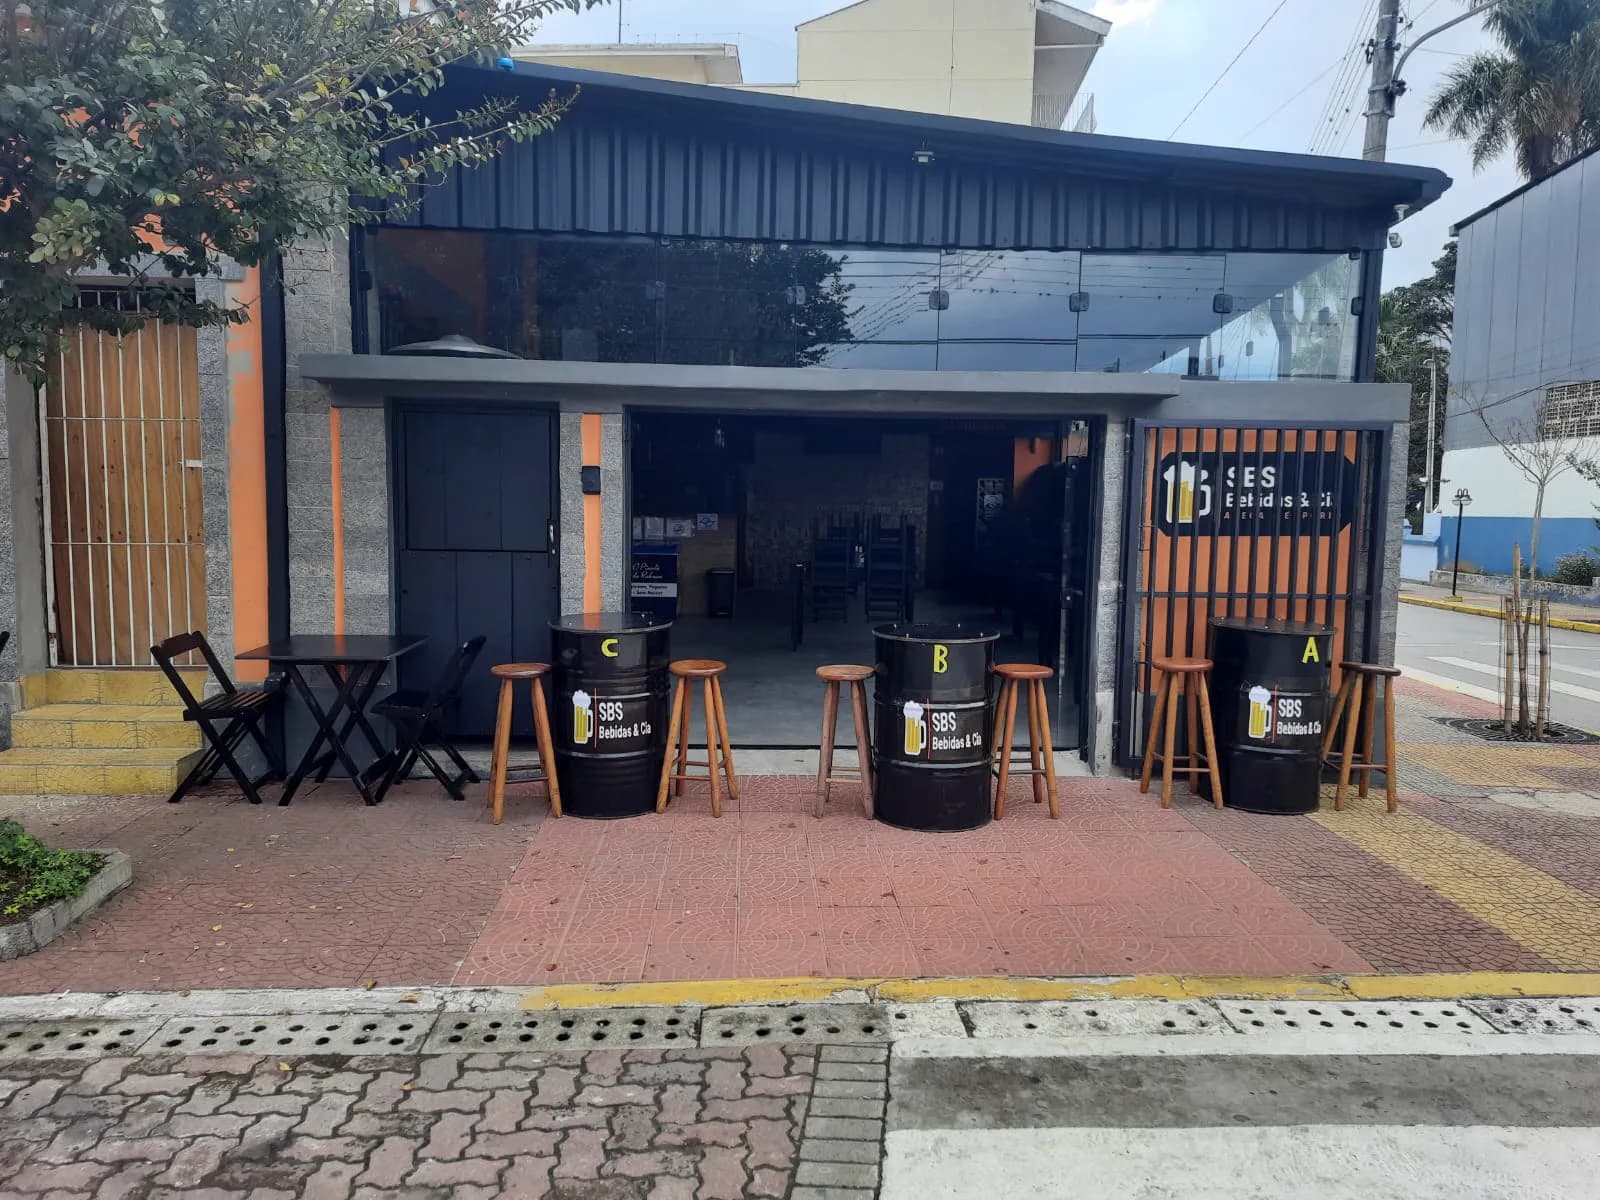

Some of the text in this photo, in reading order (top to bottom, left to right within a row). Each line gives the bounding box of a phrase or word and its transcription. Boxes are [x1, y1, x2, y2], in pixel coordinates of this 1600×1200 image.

[601, 638, 619, 657] C
[1302, 636, 1320, 664] A
[933, 644, 948, 673] B
[598, 702, 624, 722] SBS
[1278, 698, 1303, 718] SBS
[598, 720, 652, 740] Bebidas & Cia
[931, 711, 957, 732] SBS
[1276, 721, 1307, 735] Bebidas
[1307, 721, 1313, 735] &
[931, 736, 965, 750] Bebidas
[965, 734, 972, 747] &
